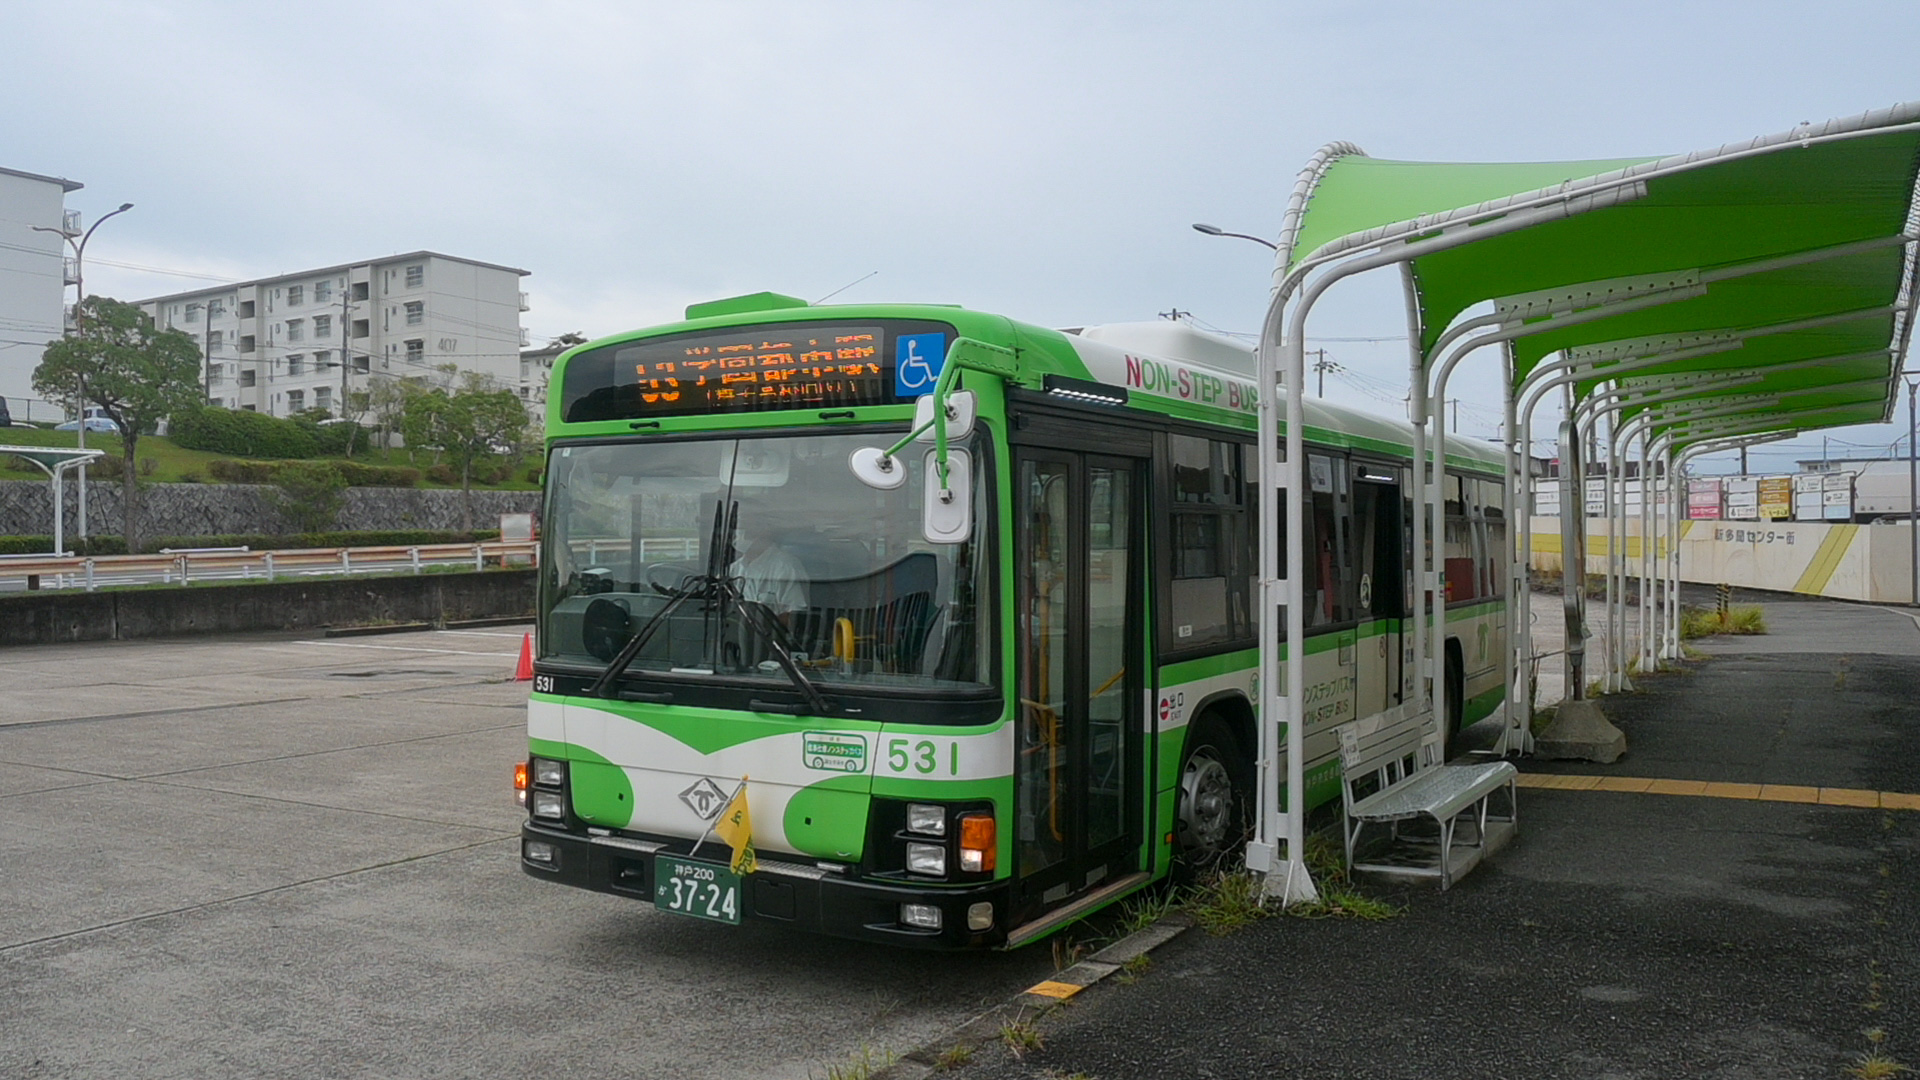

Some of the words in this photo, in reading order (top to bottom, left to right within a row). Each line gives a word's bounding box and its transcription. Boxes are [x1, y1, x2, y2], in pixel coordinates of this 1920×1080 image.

[438, 338, 458, 352] 407
[1125, 354, 1223, 404] NON-STEP
[1228, 380, 1258, 411] BUS
[536, 675, 554, 692] 531
[1169, 692, 1184, 709] 出口
[889, 739, 958, 775] 531
[669, 877, 736, 920] 37-24
